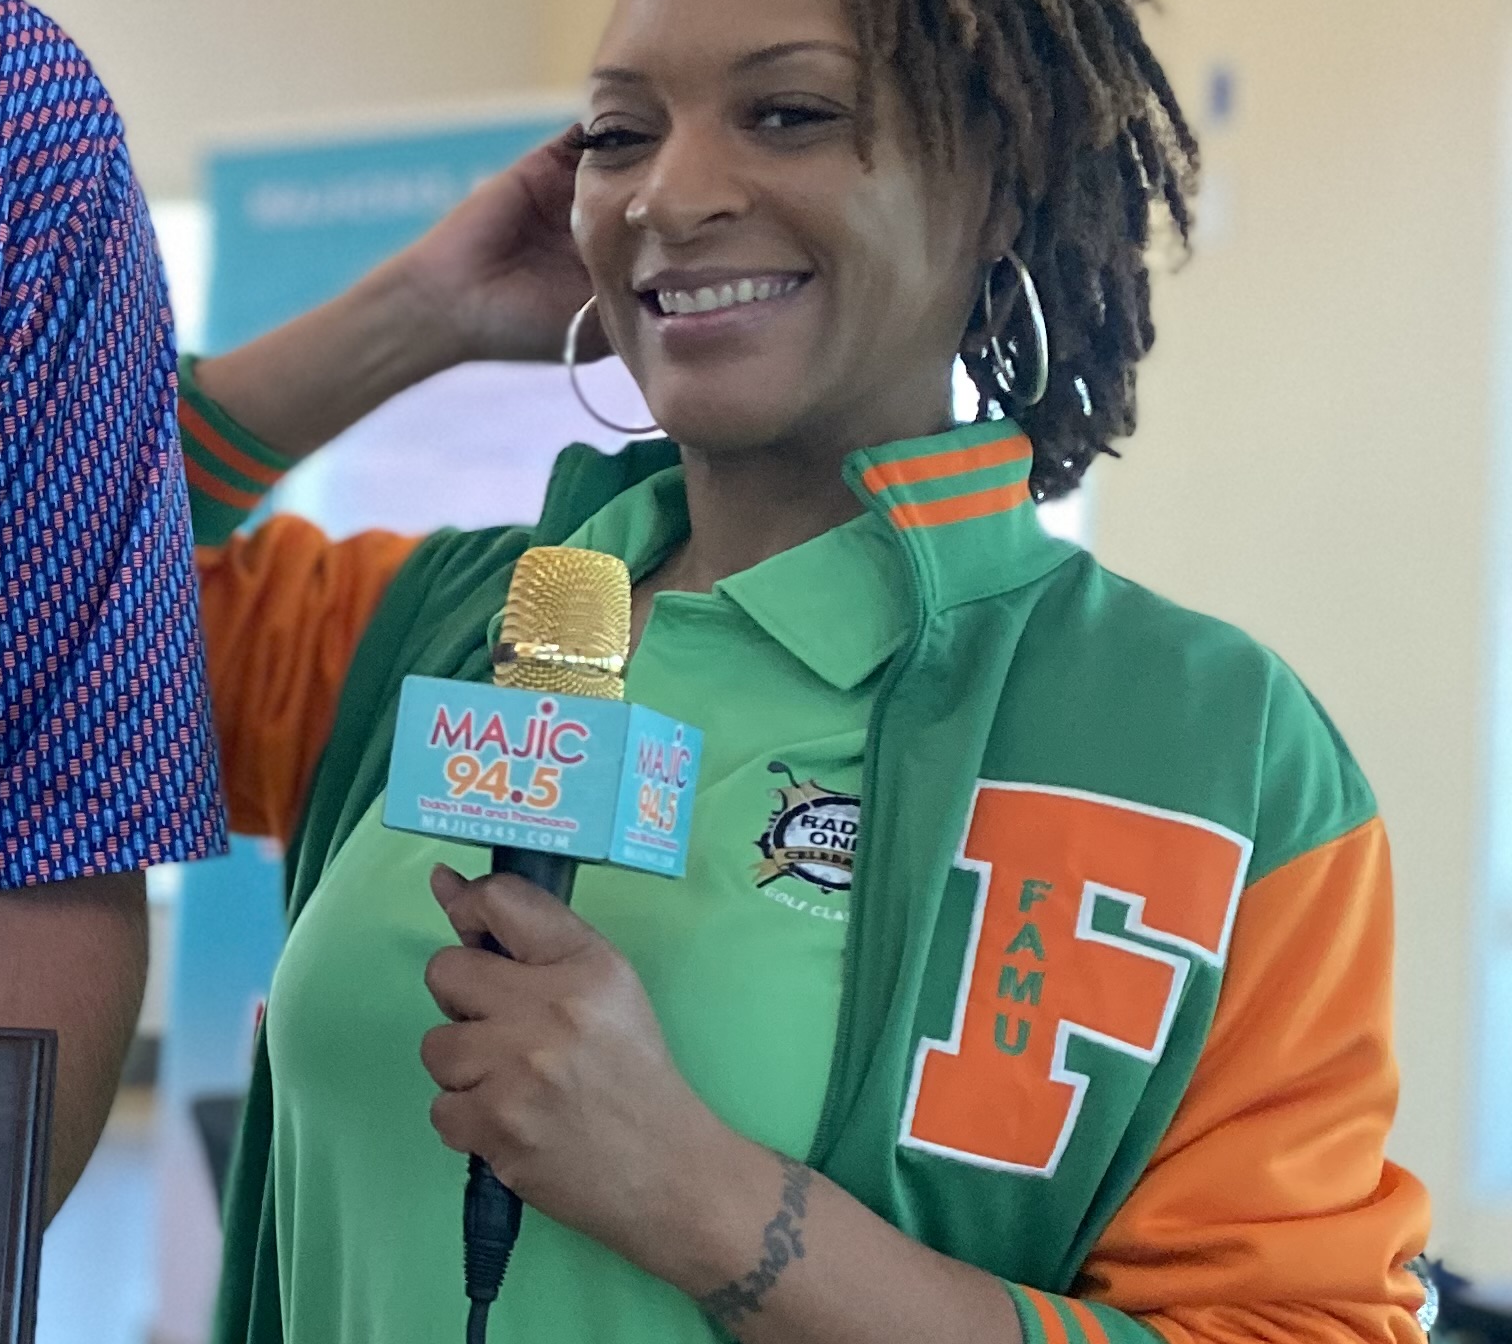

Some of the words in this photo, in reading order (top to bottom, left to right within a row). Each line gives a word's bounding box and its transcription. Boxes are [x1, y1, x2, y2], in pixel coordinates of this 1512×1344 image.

[446, 754, 561, 808] 94.5
[801, 814, 858, 835] RAD
[899, 778, 1253, 1178] F
[994, 879, 1053, 1056] FAMU
